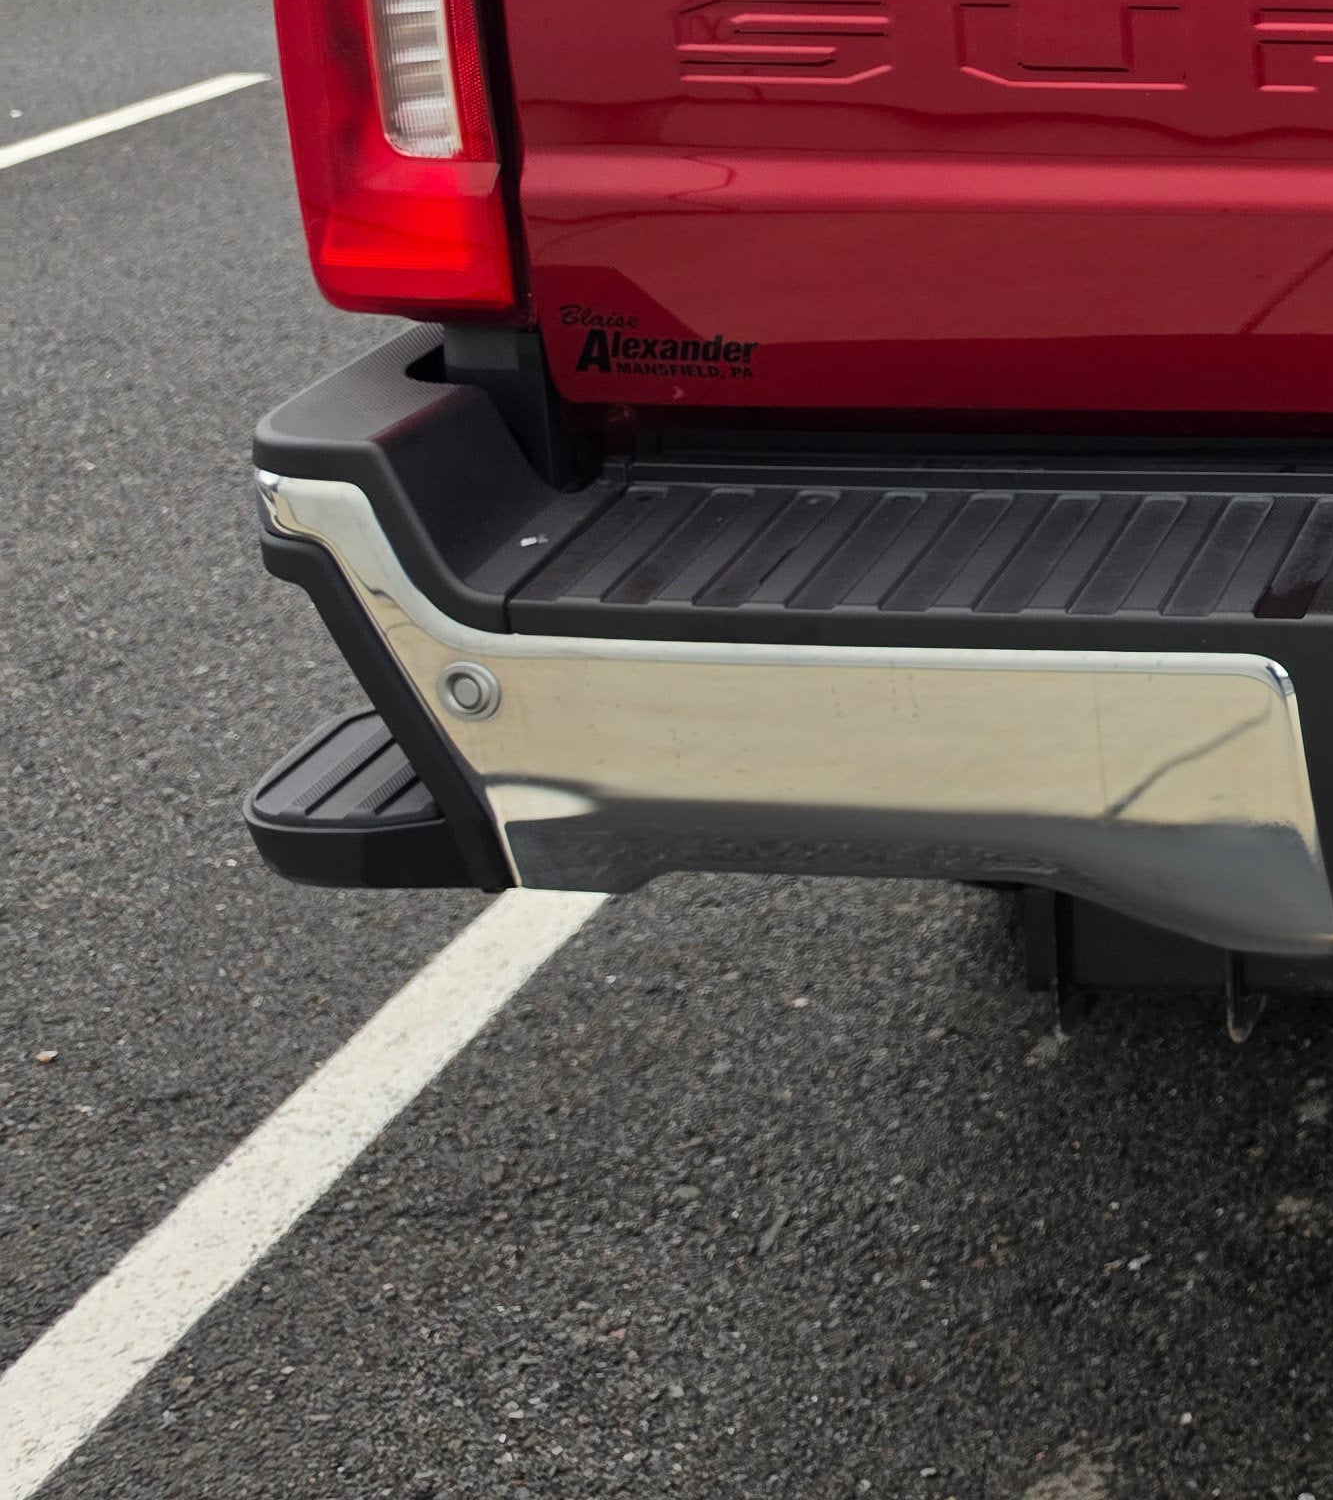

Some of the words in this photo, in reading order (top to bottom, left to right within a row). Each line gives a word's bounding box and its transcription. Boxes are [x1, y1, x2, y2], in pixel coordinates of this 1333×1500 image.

[559, 303, 640, 328] Blaise
[575, 328, 760, 373] Alexander
[616, 362, 727, 380] MANSFIELD,
[731, 367, 754, 379] PA
